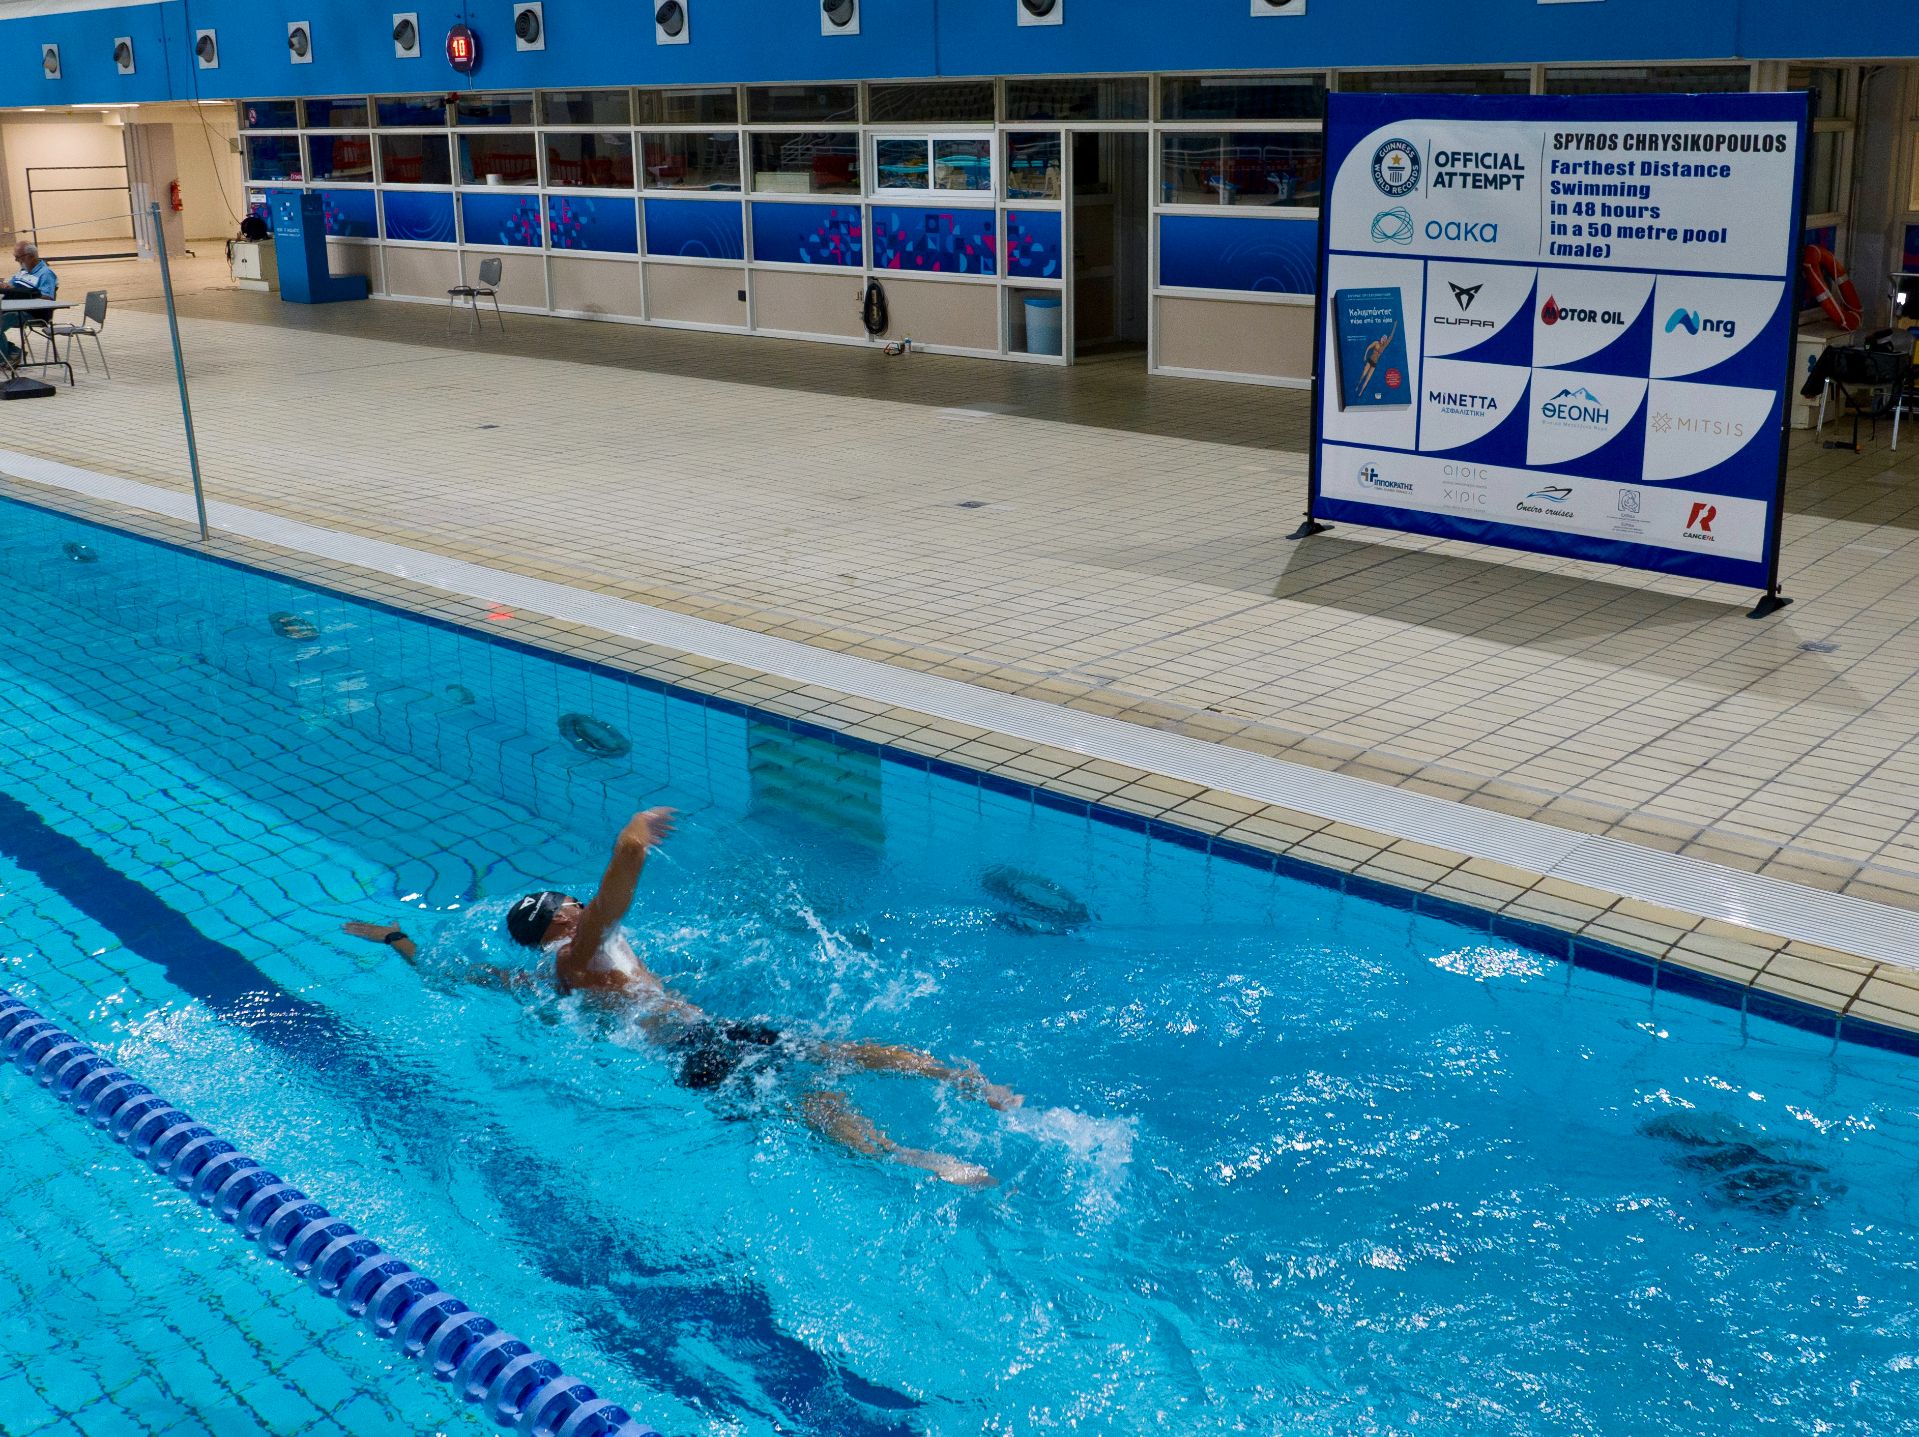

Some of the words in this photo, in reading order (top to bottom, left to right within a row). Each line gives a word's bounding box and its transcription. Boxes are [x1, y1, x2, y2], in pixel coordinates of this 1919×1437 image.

[452, 39, 466, 57] 10
[1379, 142, 1415, 158] GUINNESS
[1553, 133, 1618, 151] SPYROS
[1622, 134, 1787, 153] CHRYSIKOPOULOS
[1434, 150, 1525, 171] OFFICIAL
[1550, 160, 1636, 175] Farthest
[1640, 161, 1731, 178] Distance
[1373, 163, 1391, 192] WORLD
[1391, 164, 1419, 195] RECORDS
[1432, 171, 1525, 192] ATTEMPT
[1550, 180, 1651, 199] Swimming
[1550, 200, 1568, 216] in
[1572, 201, 1596, 217] 48
[1601, 203, 1661, 219] hours
[1425, 220, 1498, 243] oaka
[1550, 221, 1568, 237] in
[1572, 224, 1583, 237] a
[1588, 222, 1612, 238] 50
[1616, 225, 1678, 241] metre
[1682, 228, 1728, 244] pool
[1549, 241, 1611, 259] (male)
[1433, 316, 1495, 329] CUPRA
[1544, 306, 1598, 323] MOTOR
[1601, 310, 1625, 325] OIL
[1702, 318, 1736, 338] nrg
[1541, 402, 1609, 425] ΘΕΟΝΗ
[1677, 418, 1745, 438] MITSIS
[1516, 501, 1543, 514] Oneiro
[1544, 508, 1575, 519] cruises
